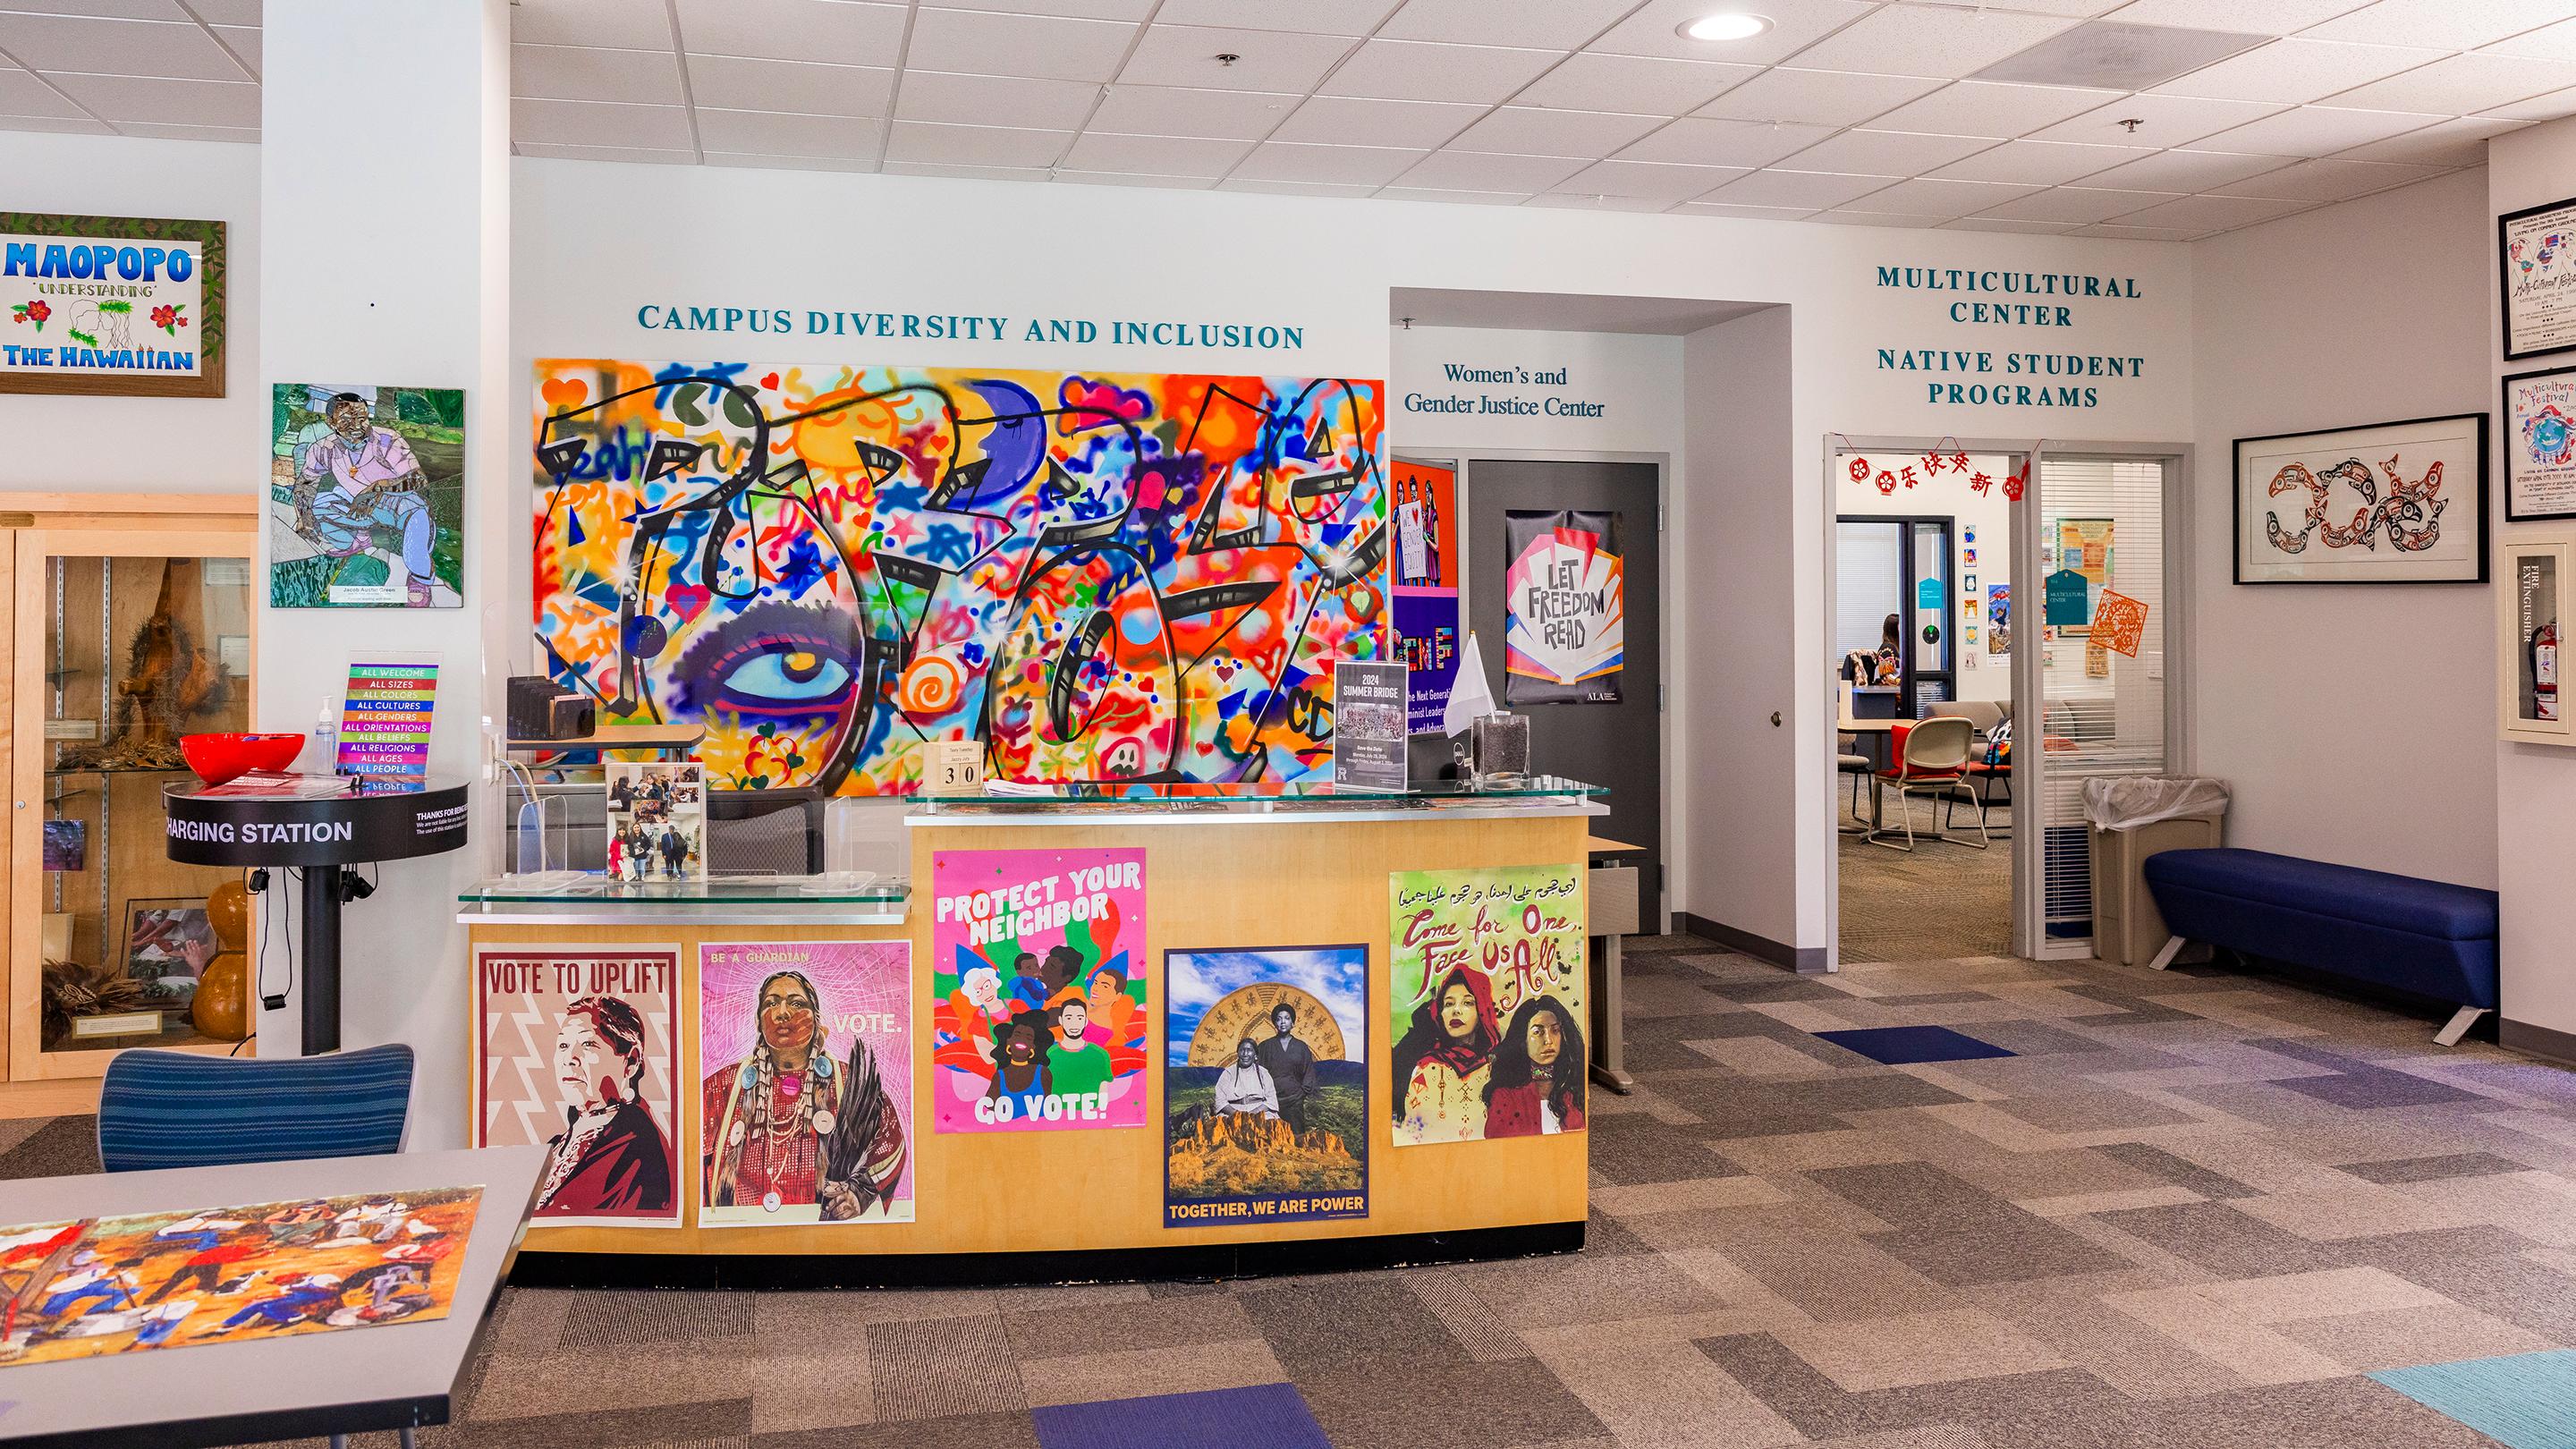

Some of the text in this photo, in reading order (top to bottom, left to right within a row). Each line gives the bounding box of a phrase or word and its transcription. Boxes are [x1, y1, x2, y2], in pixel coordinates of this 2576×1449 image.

[3, 242, 193, 283] MAOPOPO
[1877, 266, 2142, 299] MULTICULTURAL
[1950, 301, 2072, 326] CENTER
[638, 305, 1304, 350] CAMPUS DIVERSITY AND INCLUSION
[3, 344, 194, 370] THE HAWAIIAN
[1877, 348, 2145, 378] NATIVE STUDENT
[1535, 367, 1567, 386] and
[1404, 393, 1605, 418] Gender Justice Center
[1928, 383, 2097, 408] PROGRAMS
[2530, 390, 2569, 407] Festival
[1547, 558, 1580, 591] LET
[2531, 564, 2539, 589] FIRE
[1528, 586, 1606, 624] FREEDOM
[2522, 564, 2532, 643] EXTINGUISHER
[1544, 618, 1587, 651] READ
[361, 668, 426, 677] ALL WELCOME
[1362, 674, 1379, 686] 2024
[363, 691, 418, 699] ALL COLORS
[387, 681, 414, 689] SIZES
[1343, 685, 1399, 699] SUMMER BRIDGE
[1416, 690, 1429, 701] Next
[1587, 692, 1605, 701] ALA
[357, 701, 421, 710] ALL CULTURES
[358, 713, 417, 721] ALL GENDERS
[344, 724, 428, 733] ALL ORIENTATIONS
[358, 733, 411, 741] ALL BELIEFS
[350, 744, 416, 753] ALL RELIGIONS
[360, 754, 403, 763] ALL AGES
[354, 765, 407, 774] ALL PEOPLE
[416, 809, 444, 821] THANKS
[444, 808, 454, 817] FOR
[242, 821, 352, 843] STATION
[936, 860, 1142, 925] PROTECT YOUR
[969, 893, 1110, 946] NEIGHBOR
[1398, 908, 1462, 949] Come
[1467, 904, 1510, 945] for
[710, 952, 810, 964] BE A GUARDIAN
[488, 962, 667, 994] VOTE TO UPLIFT
[1406, 936, 1559, 1011] Face Us All
[833, 1013, 902, 1035] VOTE.
[974, 1091, 1108, 1125] GO VOTE!
[1169, 1196, 1364, 1220] TOGETHER, WE ARE POWER
